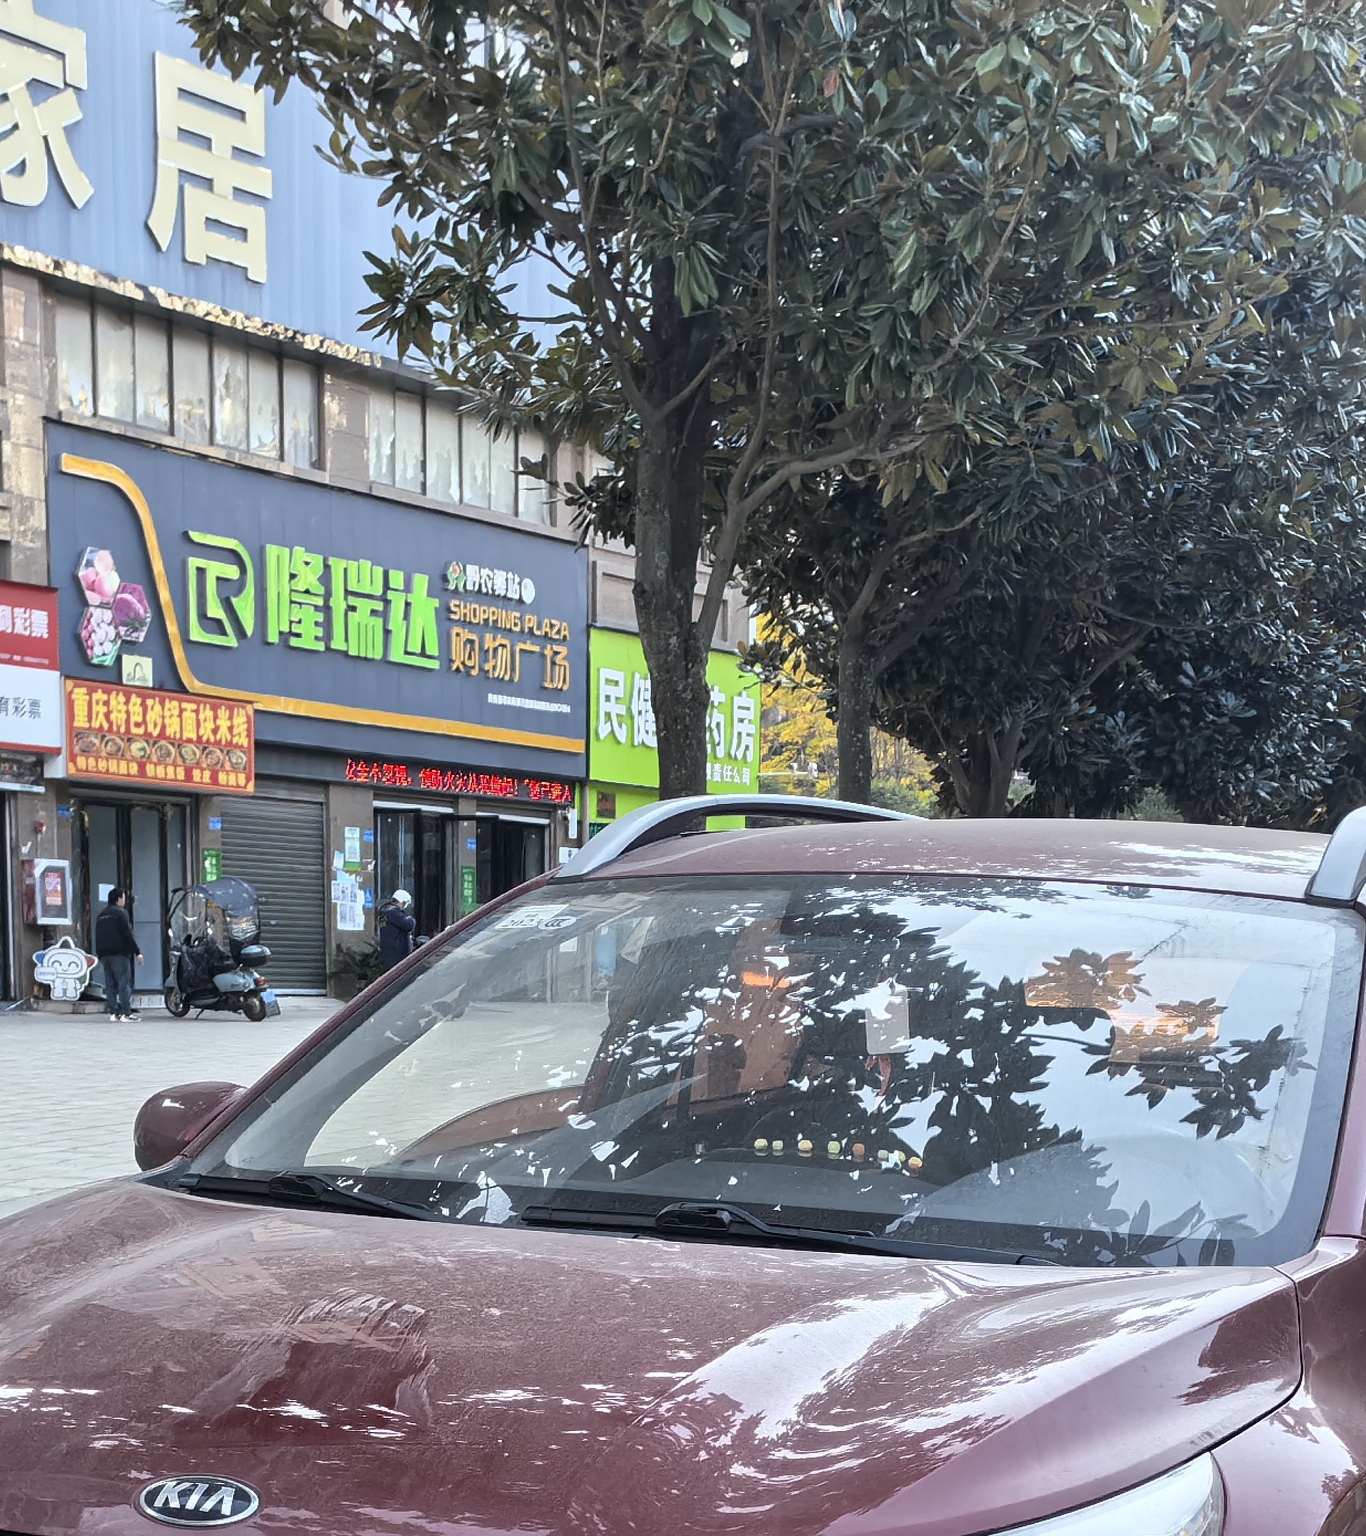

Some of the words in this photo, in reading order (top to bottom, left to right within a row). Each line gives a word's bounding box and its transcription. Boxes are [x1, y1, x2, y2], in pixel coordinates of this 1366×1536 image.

[265, 543, 440, 670] 隆瑞达
[449, 599, 521, 632] SHOPPING
[524, 613, 570, 641] PLAZA
[450, 626, 570, 692] 购物广场
[71, 687, 248, 747] 重庆特色砂锅面块米线
[153, 1480, 236, 1516] KIA
